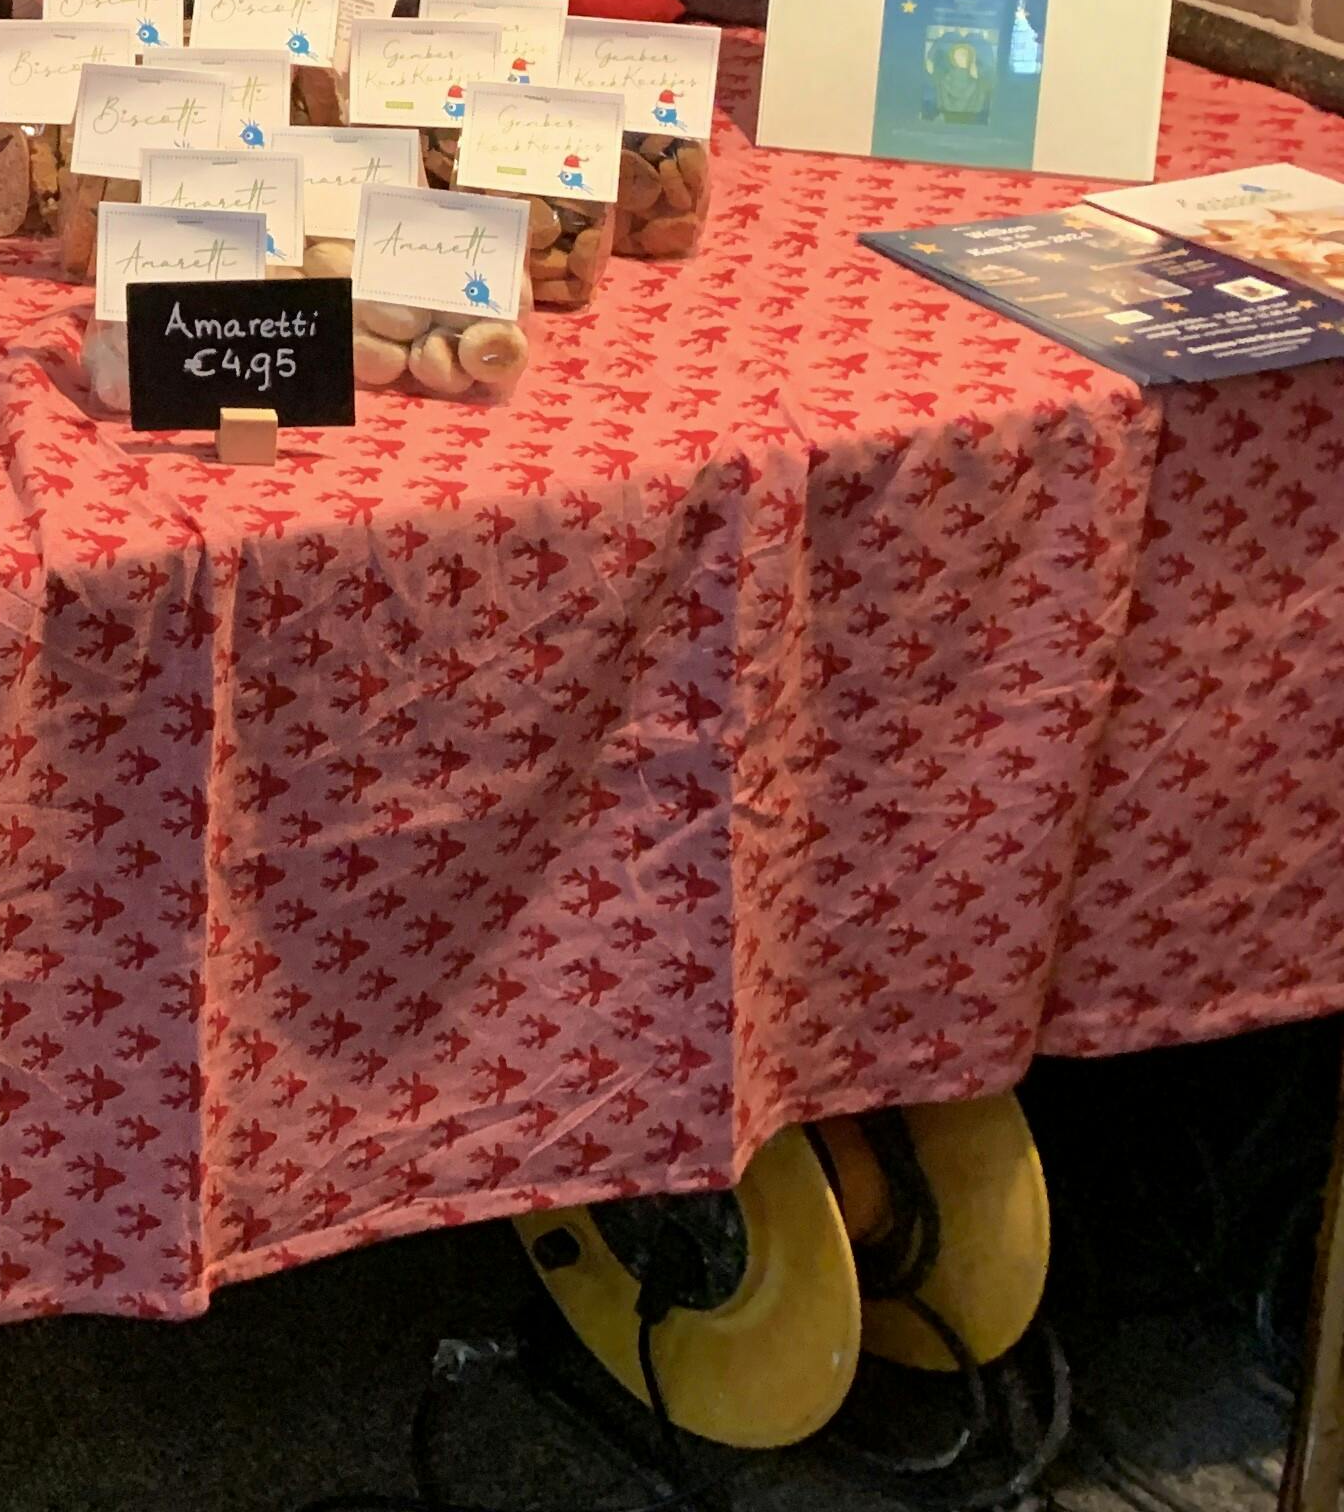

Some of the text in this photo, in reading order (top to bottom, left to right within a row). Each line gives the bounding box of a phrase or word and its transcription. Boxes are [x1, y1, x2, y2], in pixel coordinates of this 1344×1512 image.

[92, 96, 208, 137] Biscotti
[116, 239, 240, 280] Amaretti
[373, 222, 500, 266] Amaretti
[164, 301, 319, 339] Amaretti
